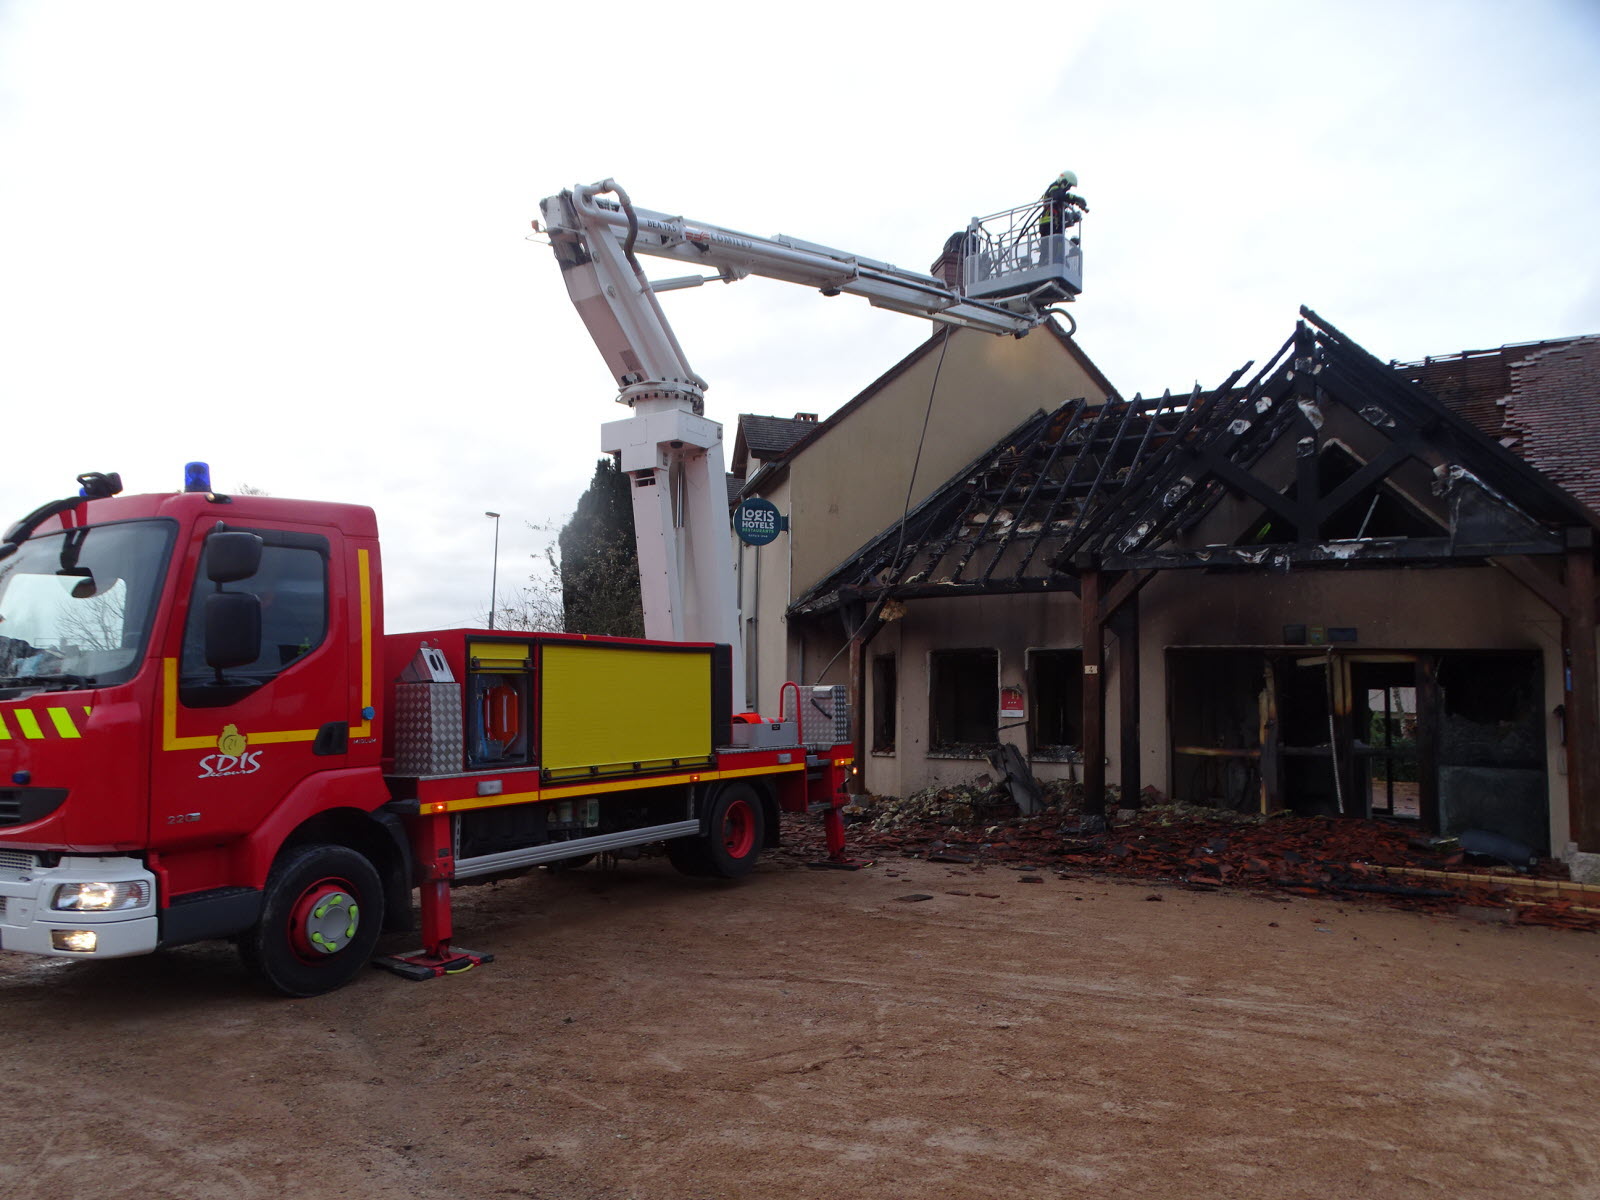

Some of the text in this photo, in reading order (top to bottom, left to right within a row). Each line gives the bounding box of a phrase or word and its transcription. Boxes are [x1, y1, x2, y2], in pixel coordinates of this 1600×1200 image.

[647, 219, 662, 230] BEA
[741, 521, 775, 529] HOTELS
[197, 750, 263, 779] SDIS
